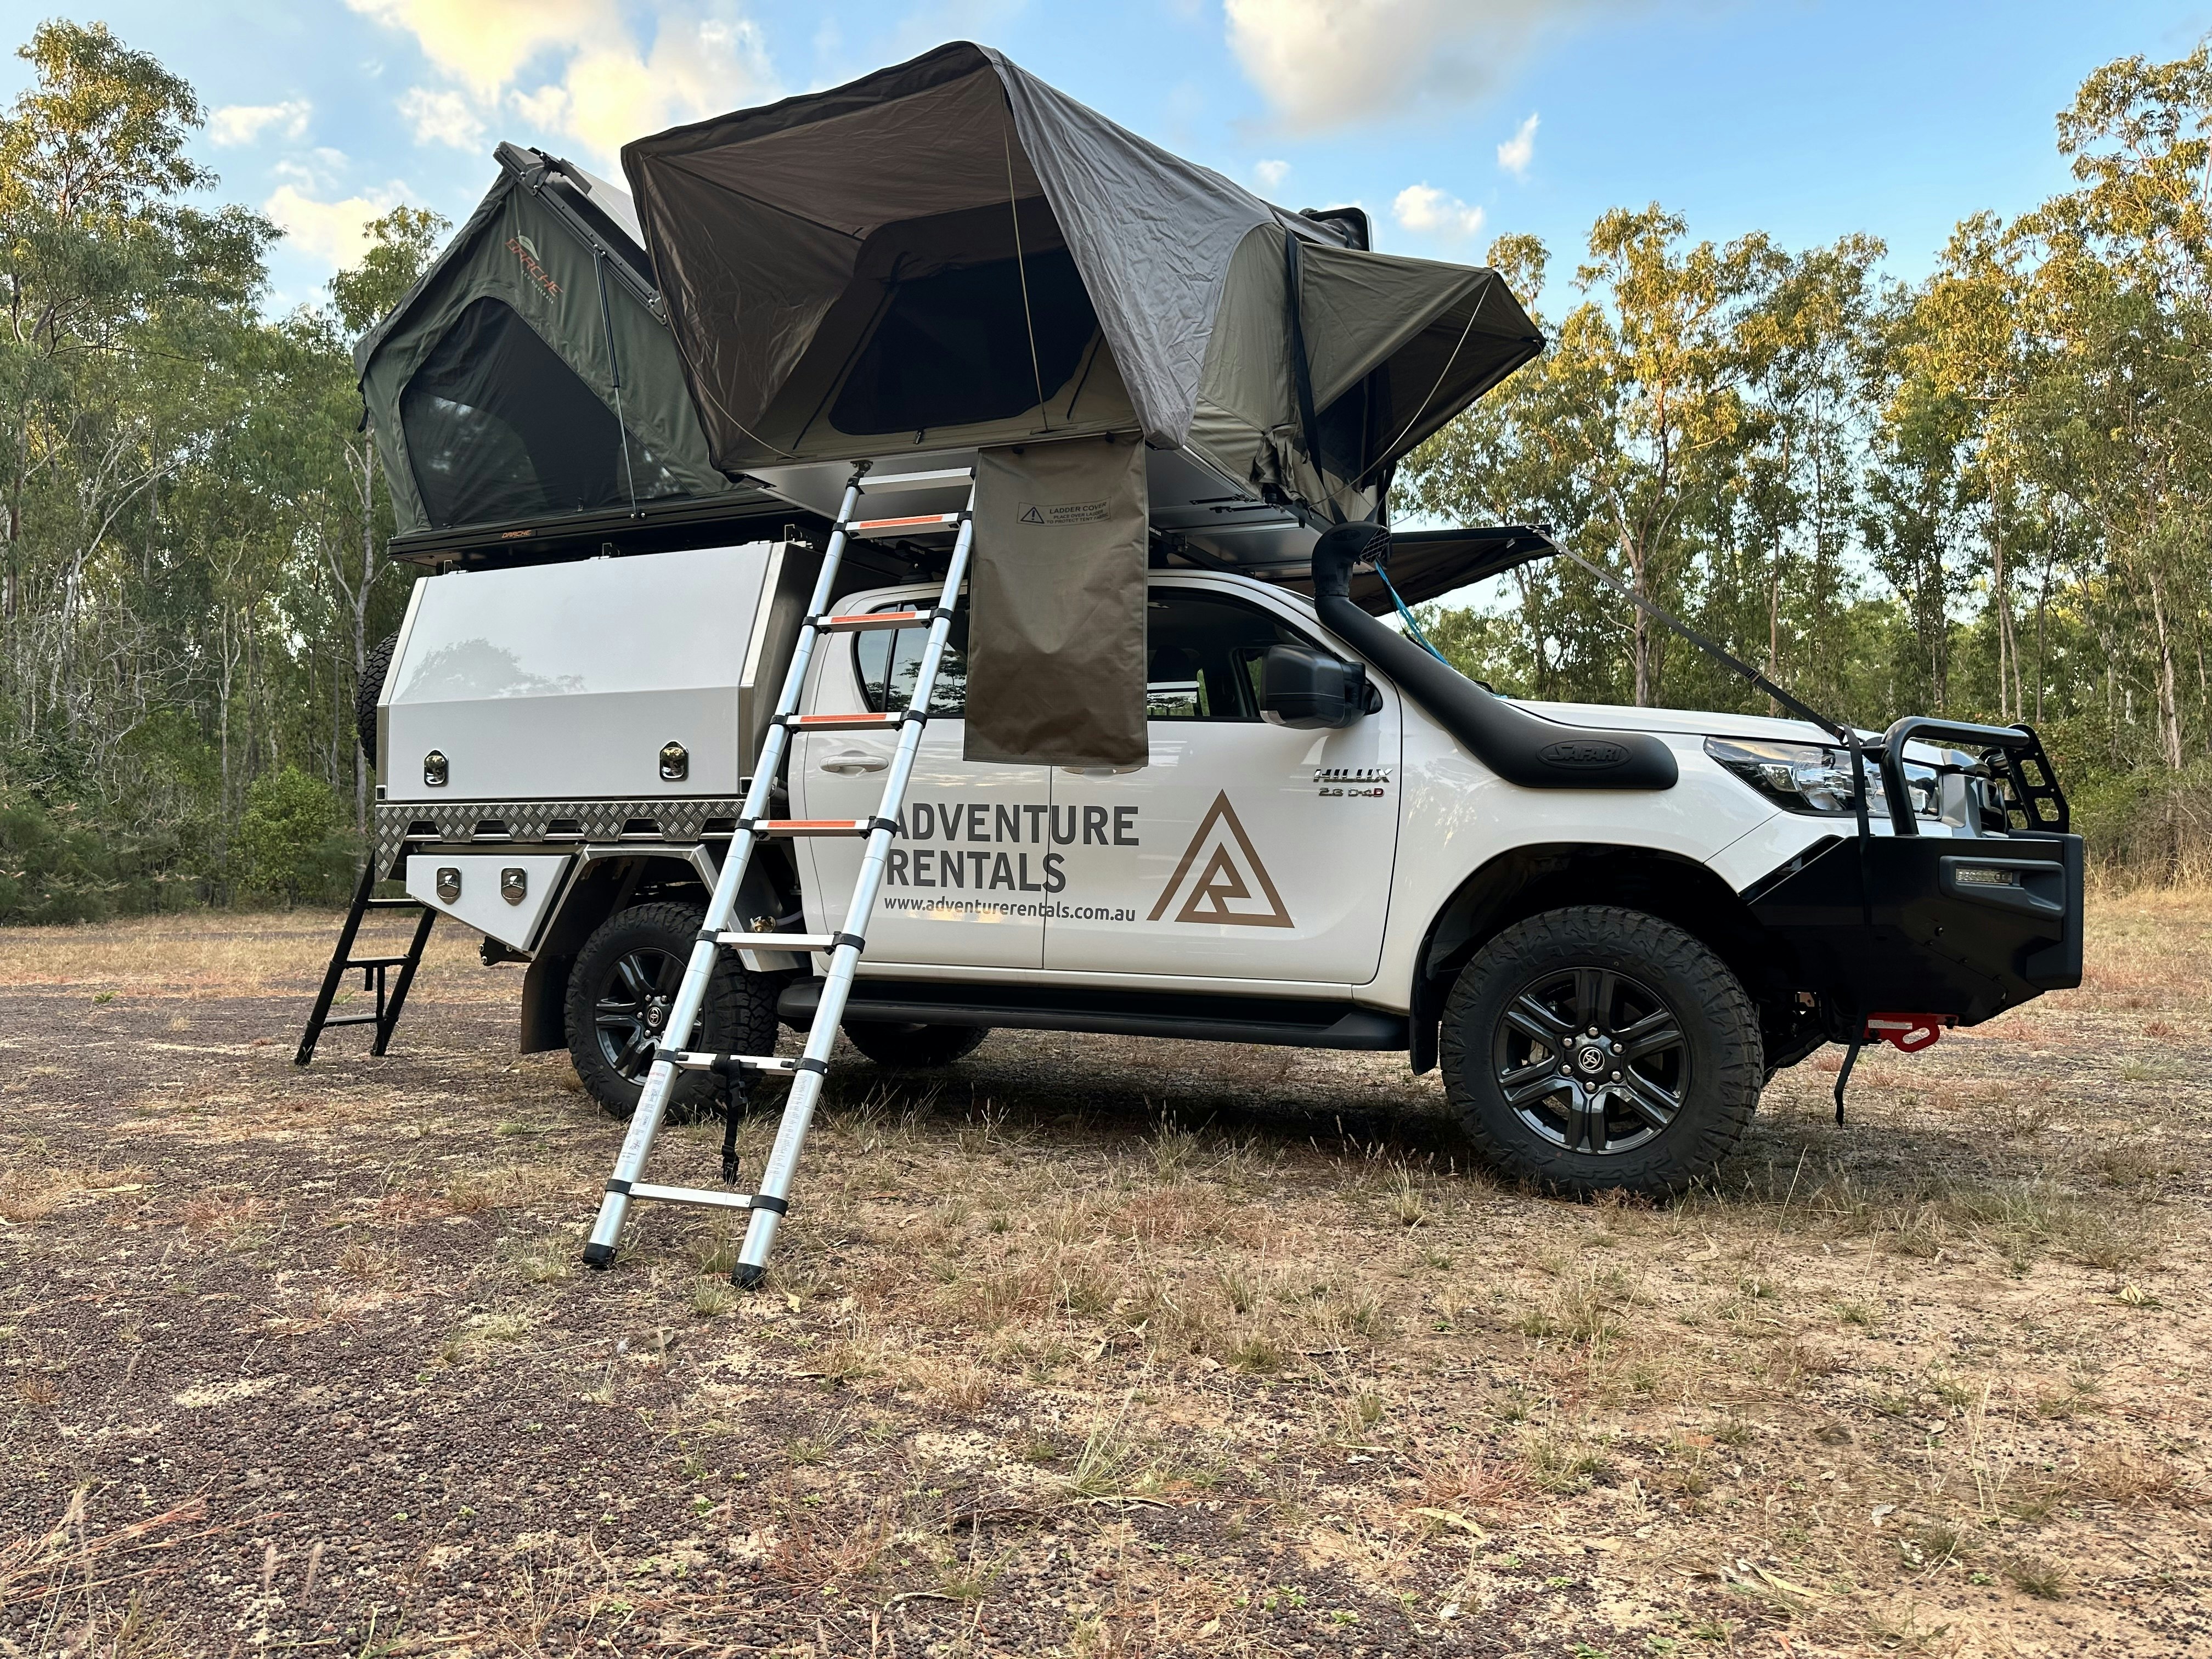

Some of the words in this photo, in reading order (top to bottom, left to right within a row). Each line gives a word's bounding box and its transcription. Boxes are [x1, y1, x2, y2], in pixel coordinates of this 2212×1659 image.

[505, 238, 564, 297] DARCHE
[1049, 506, 1081, 515] LADDER
[1082, 501, 1107, 512] COVER
[501, 529, 532, 538] DARCHE
[1548, 744, 1622, 761] SAFARI
[1313, 769, 1393, 783] HILUX
[887, 849, 1066, 893] RENTALS
[884, 896, 1136, 922] www.adventurerentals.com.au
